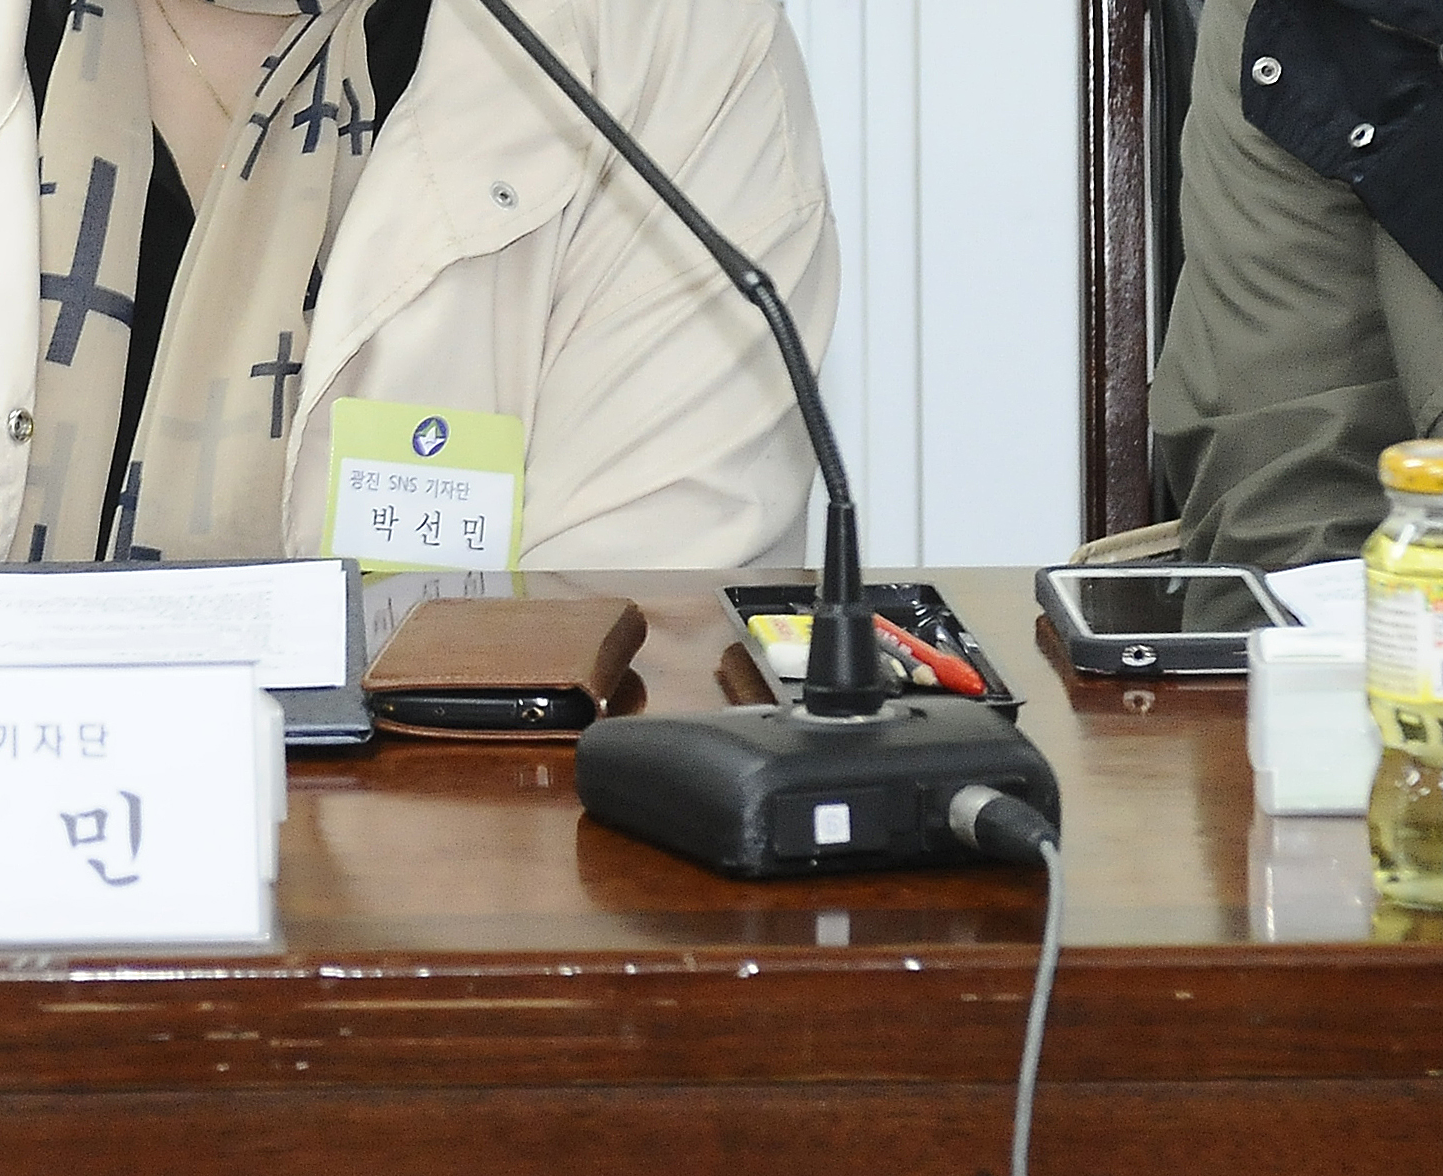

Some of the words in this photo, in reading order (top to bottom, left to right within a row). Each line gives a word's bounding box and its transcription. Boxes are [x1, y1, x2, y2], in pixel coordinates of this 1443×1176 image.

[350, 470, 380, 492] 광진
[389, 474, 418, 493] SNS
[425, 478, 470, 501] 기자단
